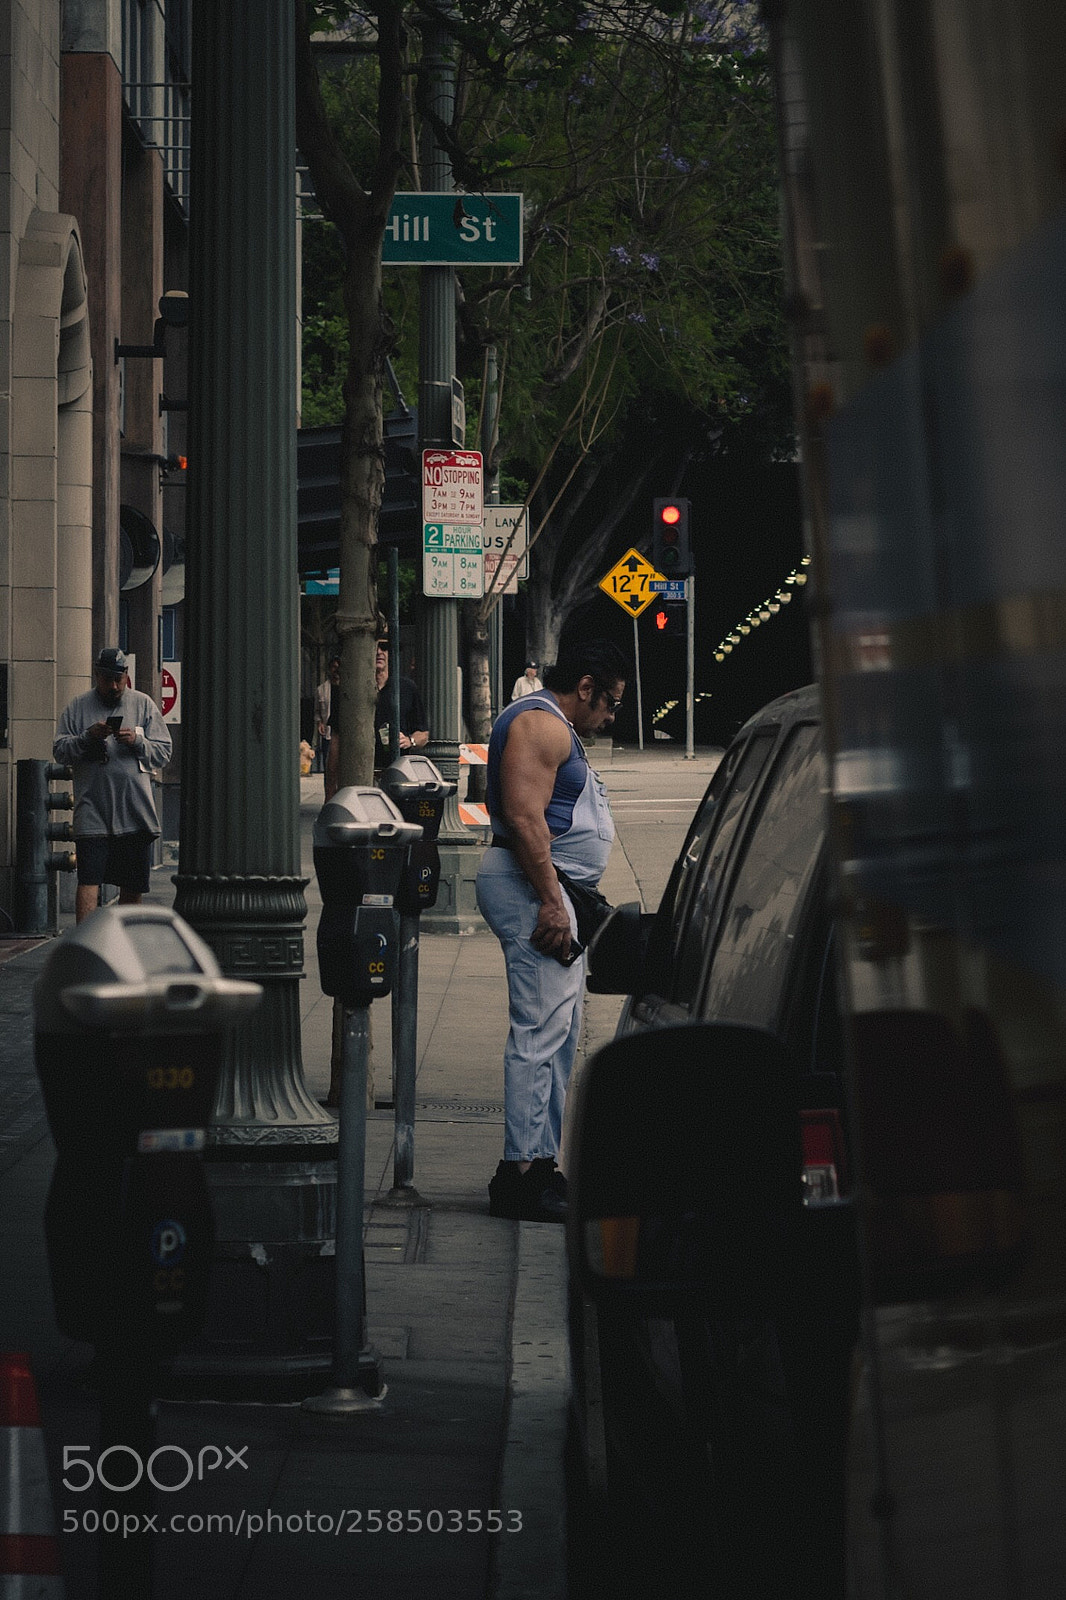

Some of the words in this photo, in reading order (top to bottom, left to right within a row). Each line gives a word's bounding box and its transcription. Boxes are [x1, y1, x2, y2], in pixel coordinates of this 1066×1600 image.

[459, 215, 496, 242] St
[424, 466, 442, 485] NO
[444, 469, 480, 485] STOPPING
[431, 487, 447, 498] 7AM
[459, 488, 475, 499] 9AM
[431, 499, 448, 510] 3PM
[459, 500, 475, 511] 7PM
[428, 526, 439, 544] 2
[453, 526, 471, 534] HOUR
[444, 533, 480, 548] PARKING
[431, 556, 448, 568] 9AM
[460, 557, 477, 569] 8AM
[460, 577, 477, 589] 8PM
[654, 581, 667, 591] Hill
[670, 582, 679, 591] St
[369, 961, 385, 973] CC
